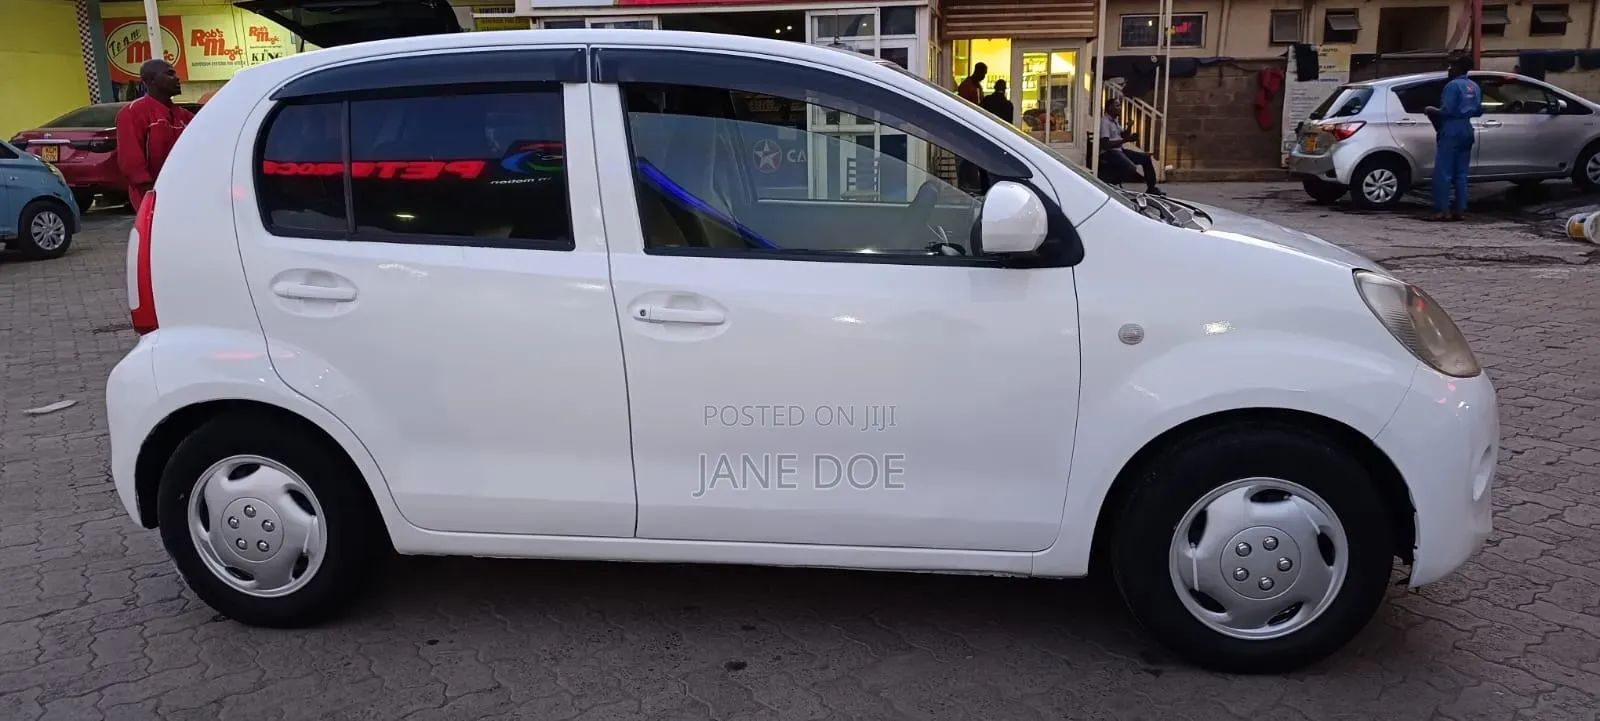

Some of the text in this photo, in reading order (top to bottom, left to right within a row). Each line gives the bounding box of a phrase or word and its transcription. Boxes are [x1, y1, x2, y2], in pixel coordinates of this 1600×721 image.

[191, 28, 224, 47] Rob's
[202, 37, 244, 61] Magic
[126, 40, 175, 64] Mic
